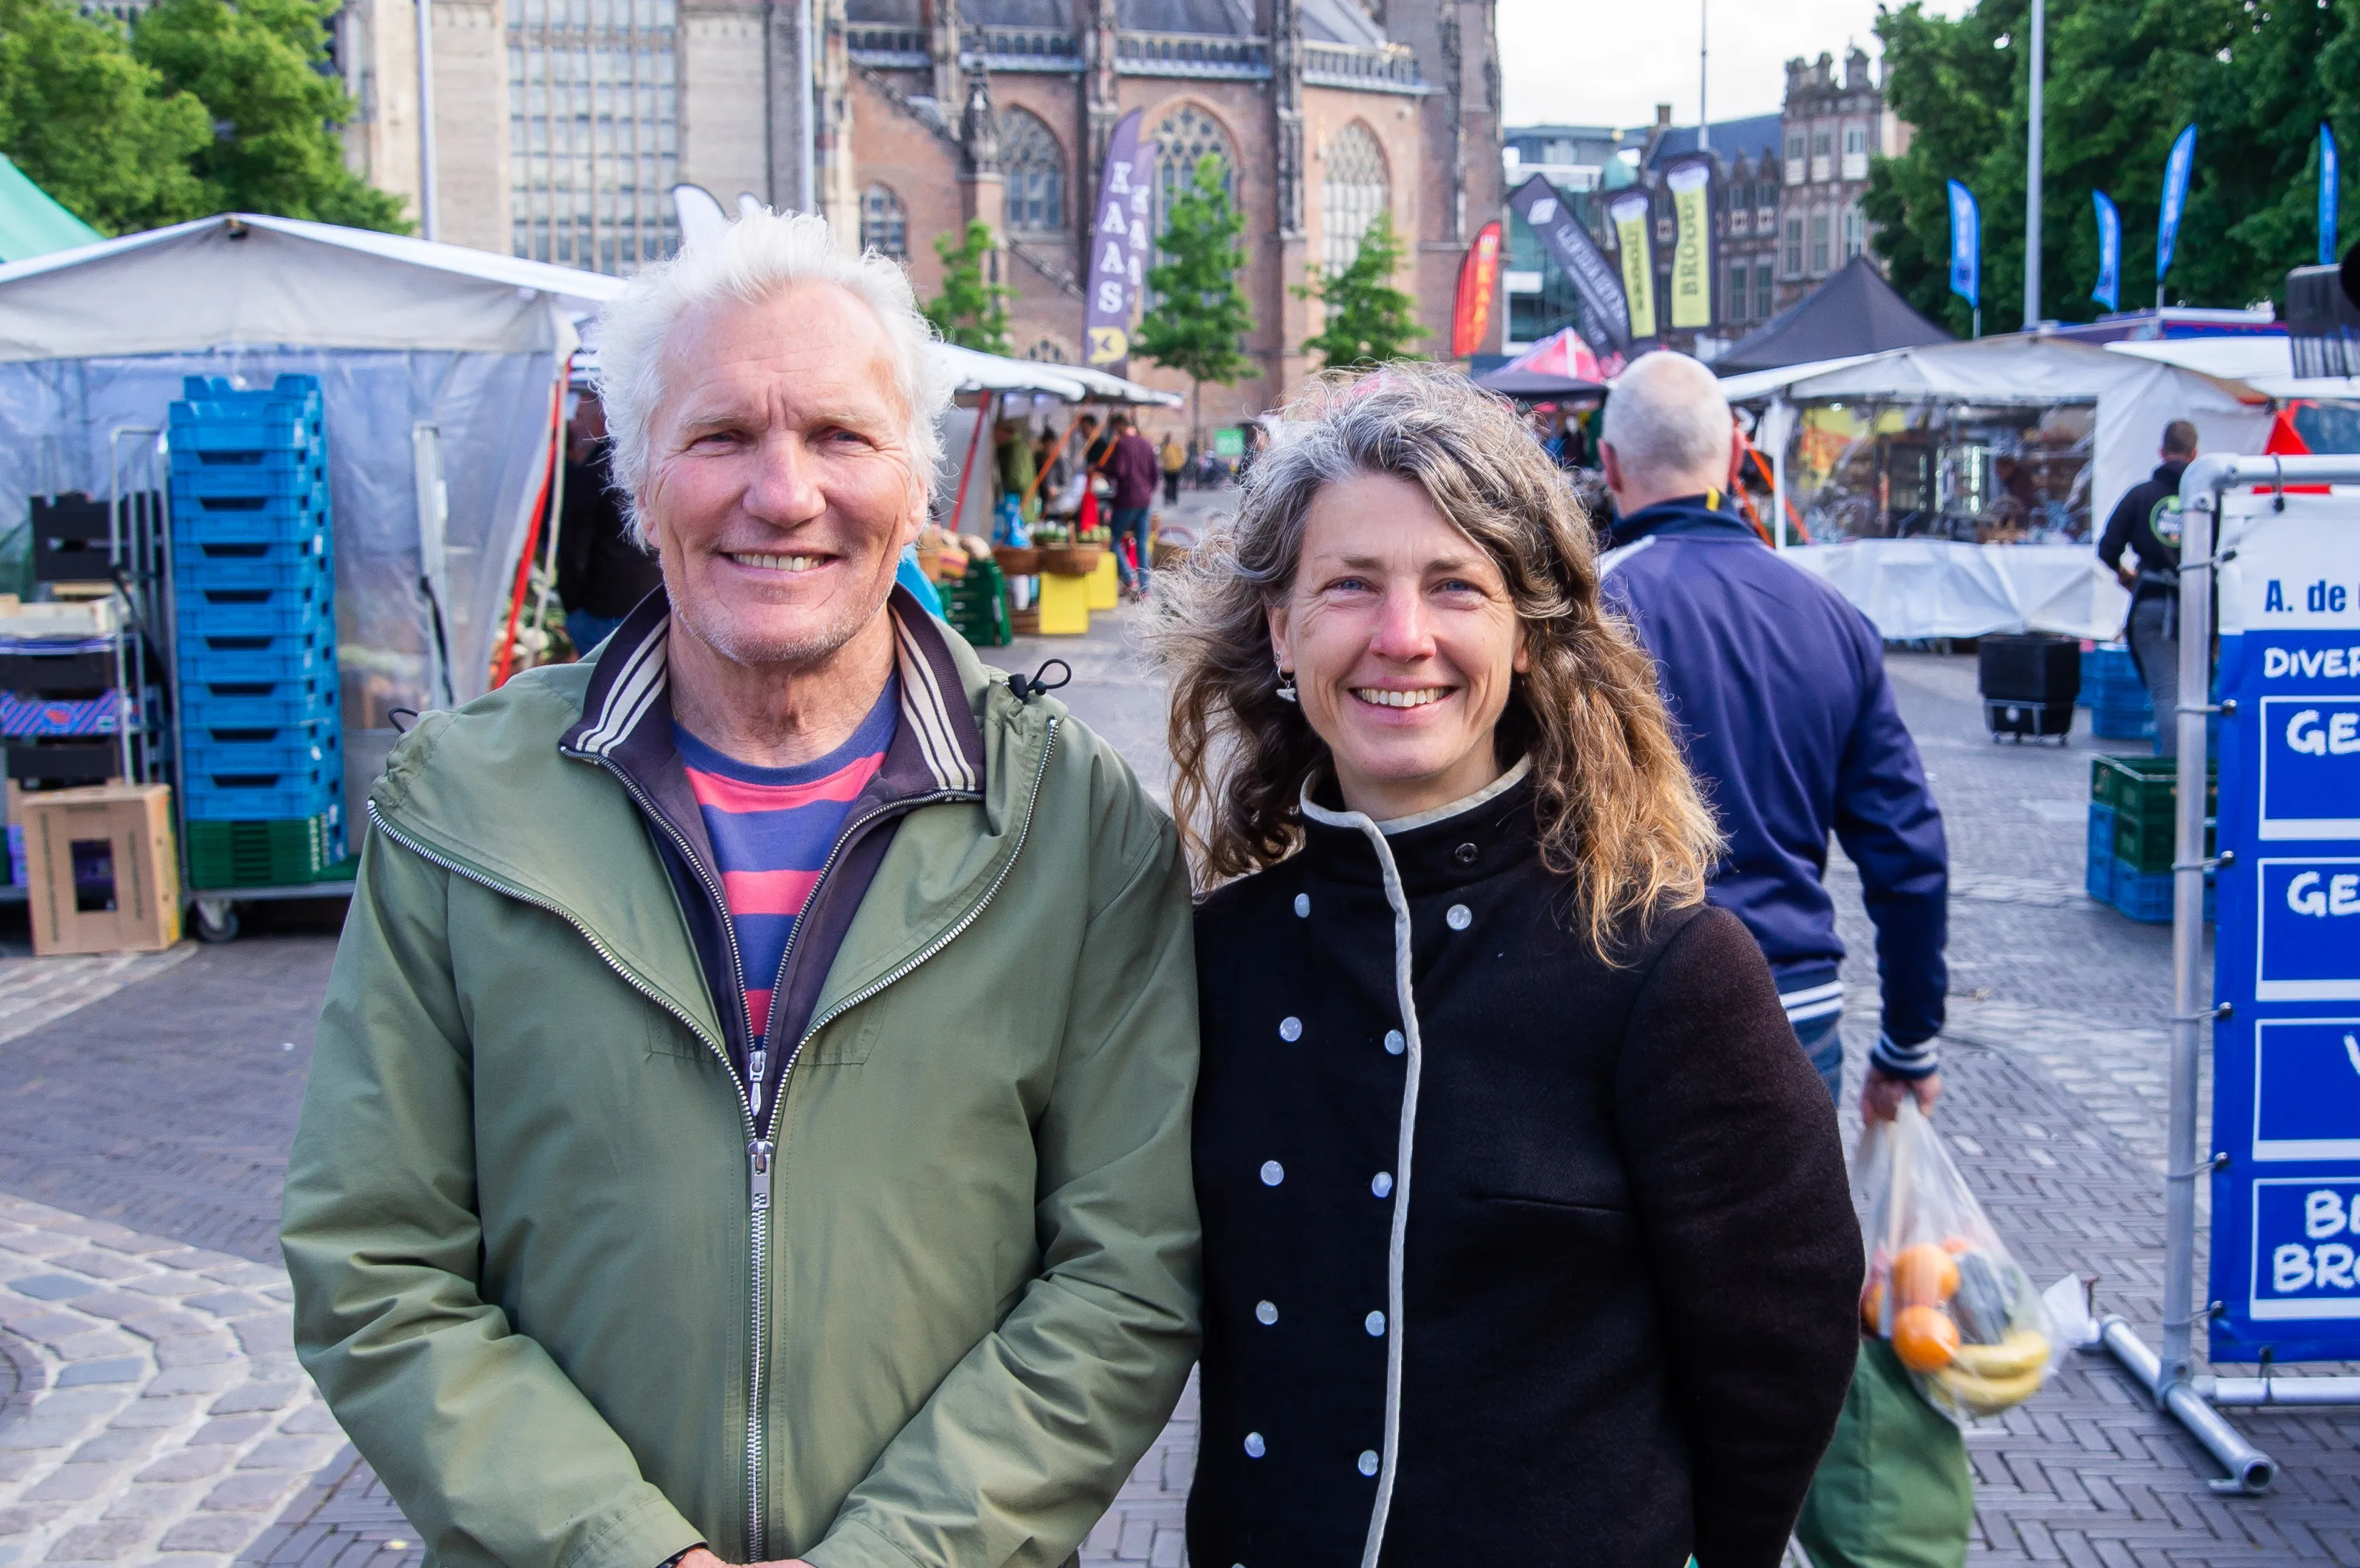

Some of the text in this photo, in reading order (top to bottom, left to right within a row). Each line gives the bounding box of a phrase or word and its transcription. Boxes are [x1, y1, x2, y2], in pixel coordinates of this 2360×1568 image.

[2264, 579, 2346, 612] A. de
[2286, 709, 2360, 756] GE
[2287, 871, 2360, 917] GE
[2274, 1243, 2360, 1293] BR
